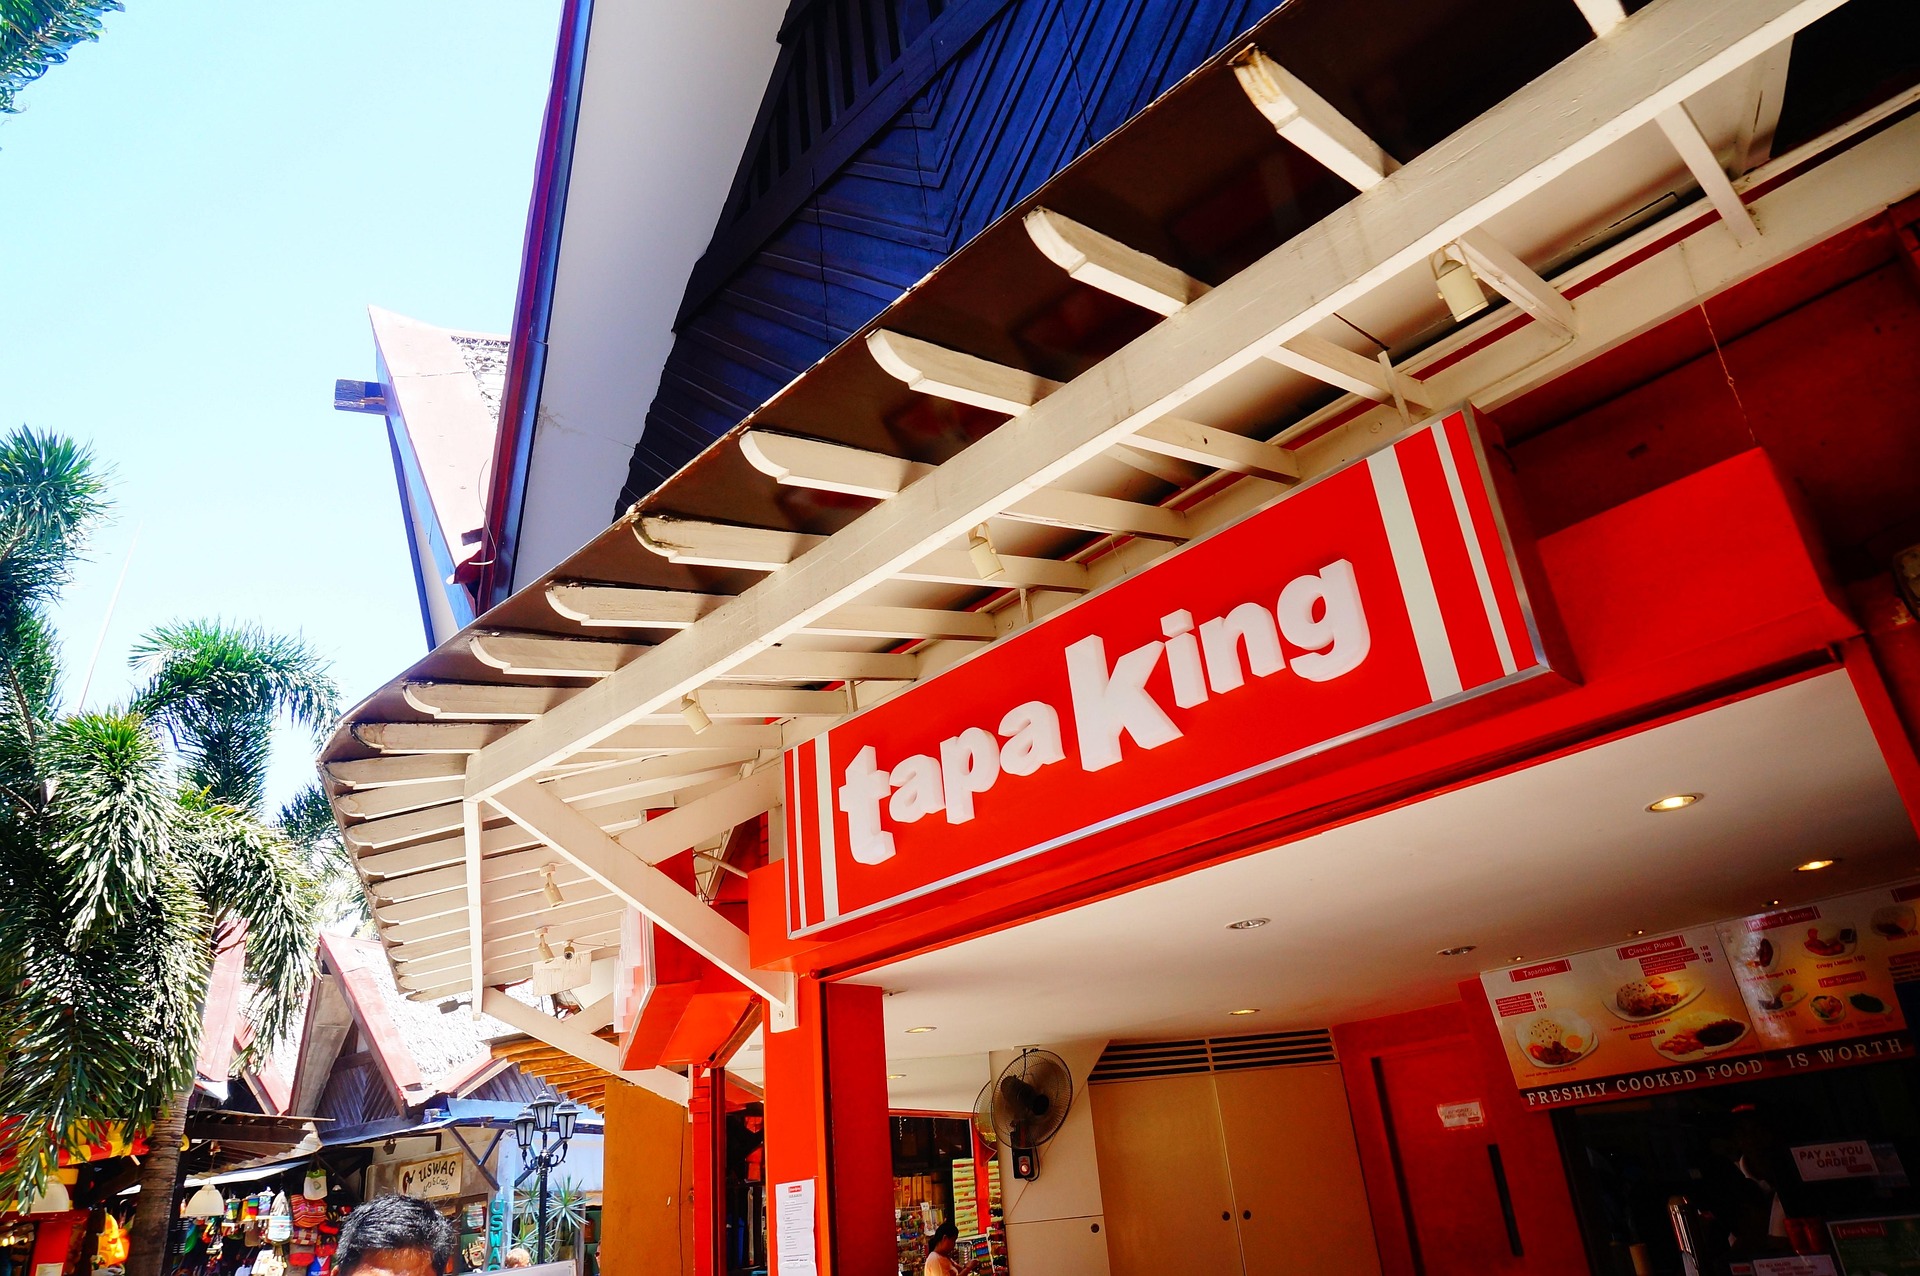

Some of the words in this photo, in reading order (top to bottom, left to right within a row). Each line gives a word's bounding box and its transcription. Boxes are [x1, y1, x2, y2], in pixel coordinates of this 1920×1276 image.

[838, 697, 1066, 867] tapa
[1063, 557, 1371, 773] king
[1628, 946, 1652, 956] Classic
[1654, 940, 1675, 951] Plates
[1522, 965, 1557, 978] Tapantastic
[1526, 1082, 1608, 1106] FRESHLY
[1615, 1070, 1695, 1093] COOKED
[1706, 1058, 1763, 1081] FOOD
[1787, 1052, 1807, 1071] IS
[1818, 1038, 1904, 1066] WORTH
[1800, 1151, 1822, 1161] PAY
[1839, 1146, 1864, 1157] YOU
[1818, 1157, 1857, 1168] ORDER
